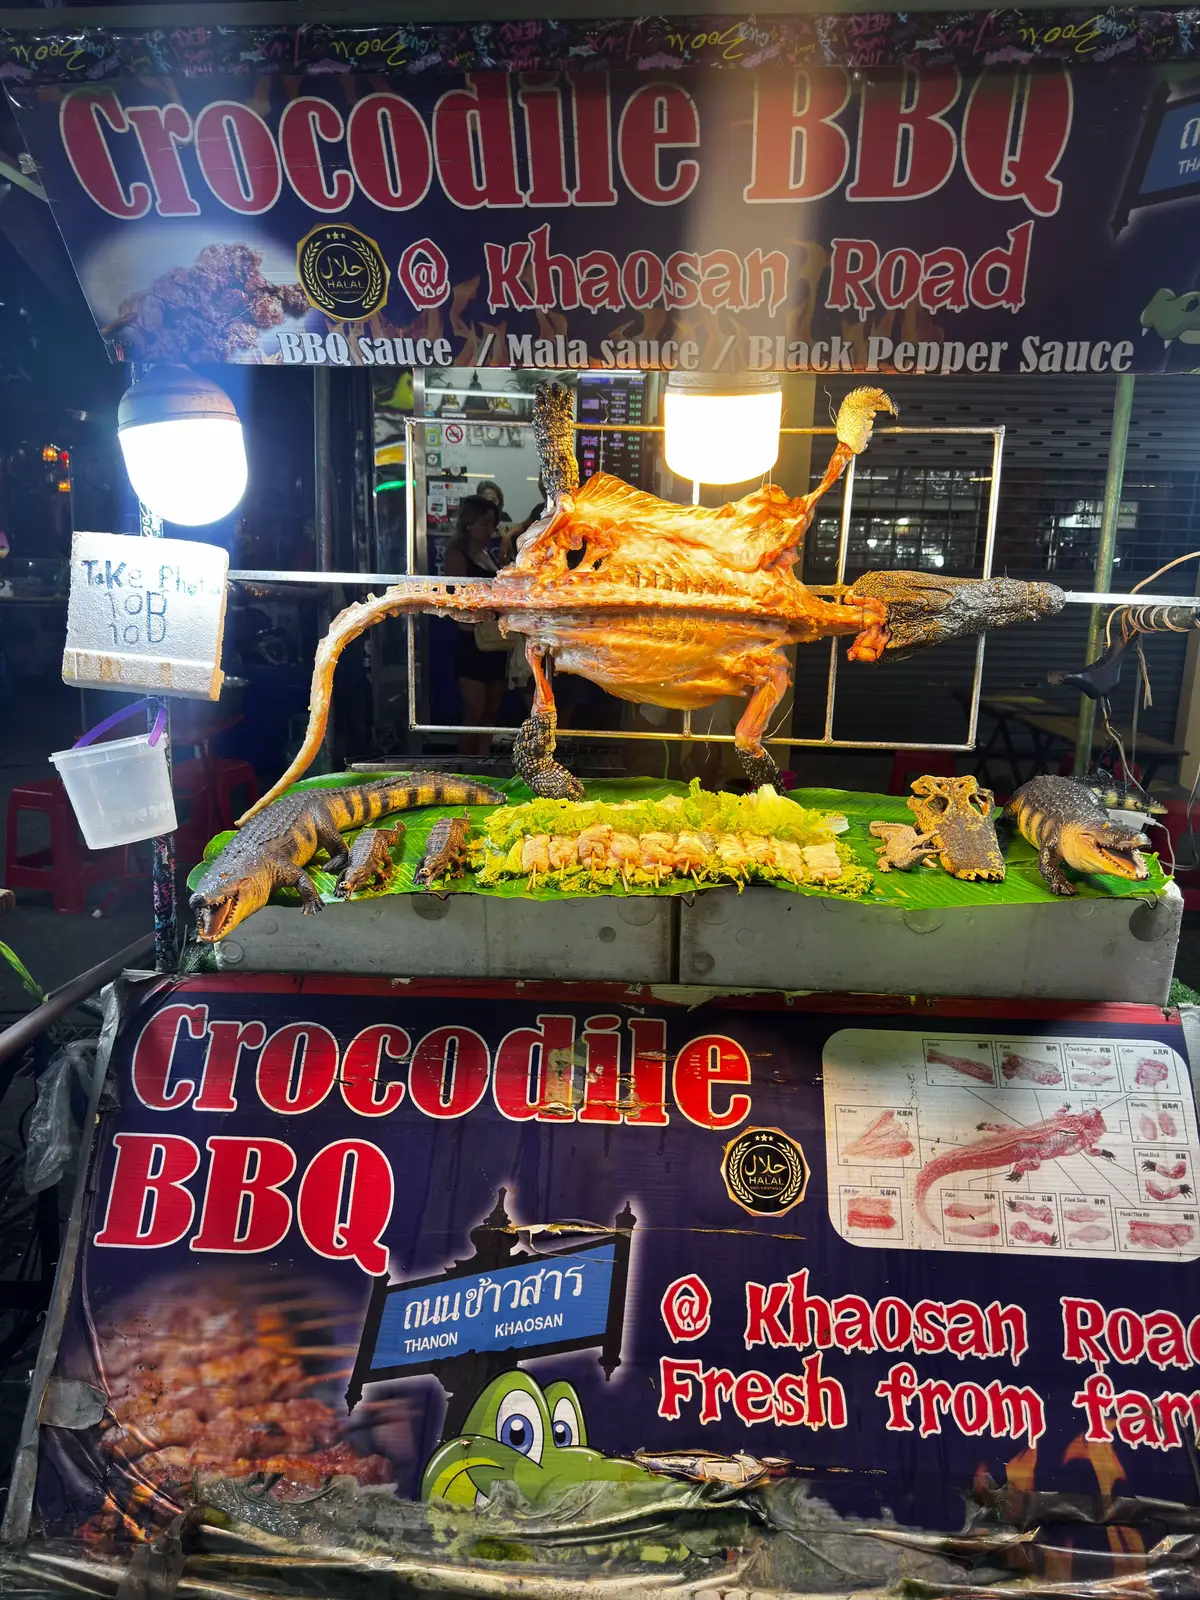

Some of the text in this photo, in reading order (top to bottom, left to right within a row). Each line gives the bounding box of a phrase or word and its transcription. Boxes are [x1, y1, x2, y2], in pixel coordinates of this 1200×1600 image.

[59, 66, 1073, 220] Crocodile BBQ
[320, 255, 365, 280] حلال
[327, 280, 365, 289] HALAL
[397, 220, 1034, 321] @ Khaosan Road
[276, 332, 351, 366] BBQ
[361, 336, 453, 366] sauce
[507, 334, 590, 368] Mala
[600, 338, 700, 371] sauce
[748, 336, 853, 373] Black
[867, 337, 1008, 375] Pepper
[1020, 336, 1135, 372] Sauce
[131, 1003, 754, 1132] Crocodile
[744, 1154, 787, 1176] حلال
[749, 1176, 785, 1186] HALAL
[94, 1132, 396, 1277] BBQ
[404, 1313, 563, 1354] THANON KHAOSAN
[661, 1267, 1200, 1373] @ Khaosan Roa
[658, 1351, 1200, 1452] Fresh from far
